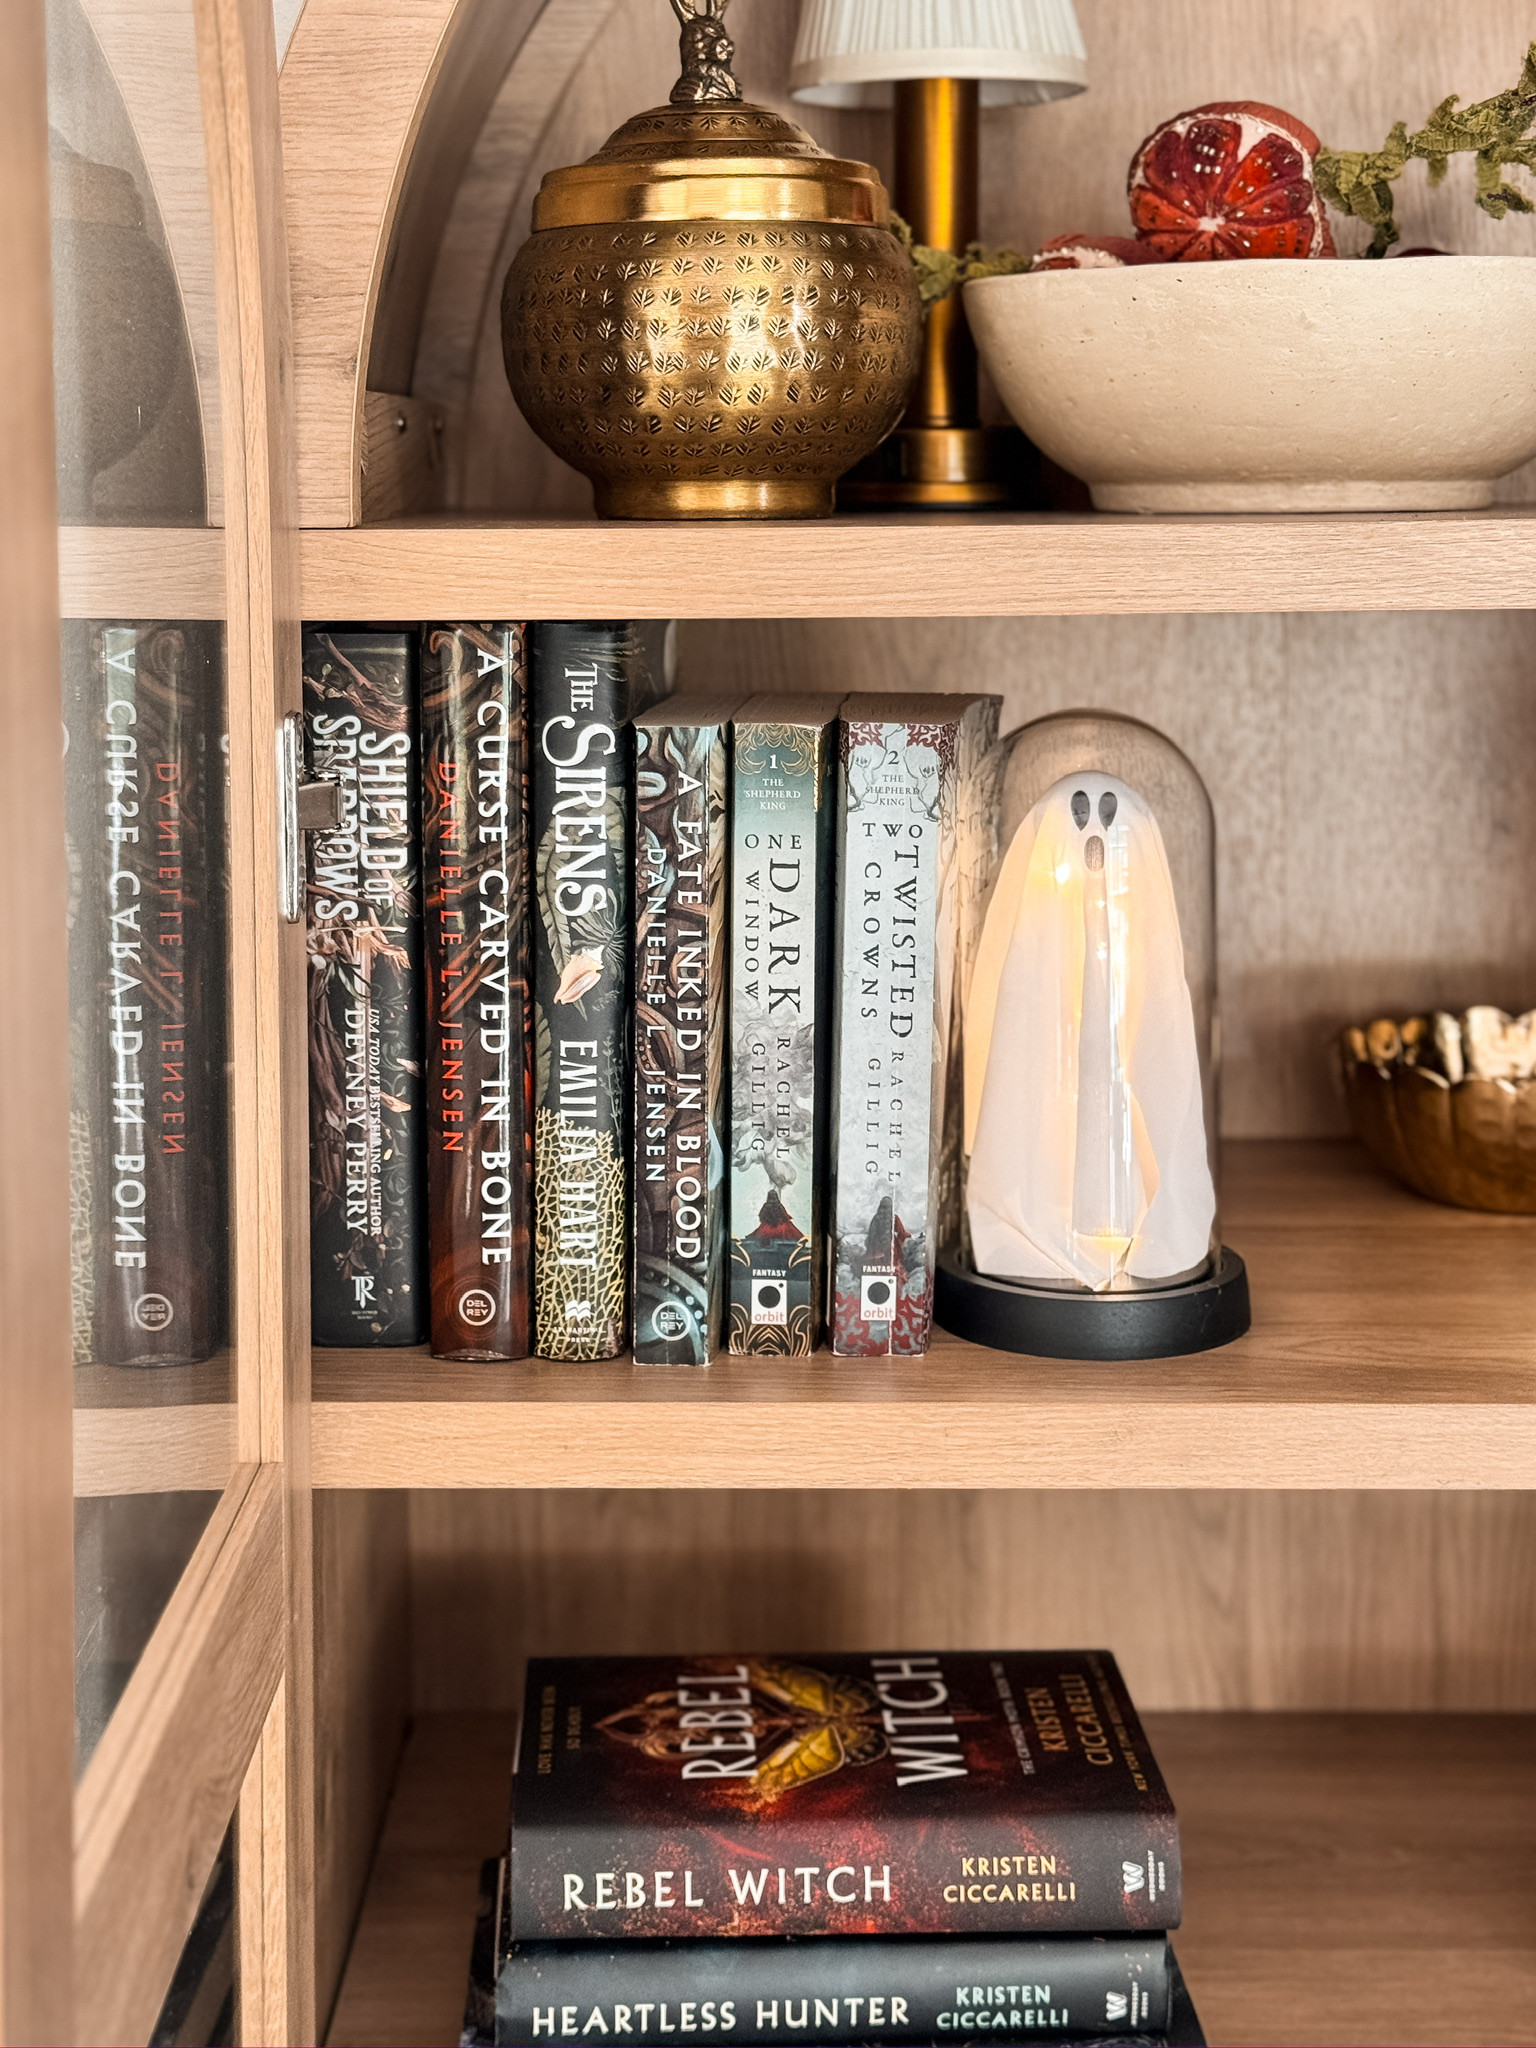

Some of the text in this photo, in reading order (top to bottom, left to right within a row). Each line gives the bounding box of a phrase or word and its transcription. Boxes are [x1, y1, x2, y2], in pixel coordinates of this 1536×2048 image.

[768, 754, 778, 770] 1
[882, 774, 905, 783] THE
[887, 750, 900, 766] 2
[541, 664, 616, 916] THE SIRENS
[744, 789, 801, 800] SHEPHERD
[762, 778, 785, 788] THE
[865, 786, 920, 796] SHEPHERD
[879, 797, 906, 807] KING
[359, 732, 411, 907] SHIELD OF
[759, 800, 786, 811] KING
[744, 833, 802, 850] ONE
[862, 823, 923, 840] TWO
[437, 761, 464, 1152] DANIELLE L. JENSEN
[744, 870, 760, 1001] WINDOW
[767, 857, 802, 1015] DARK
[860, 861, 882, 1019] CROWNS
[889, 846, 920, 1039] TWISTED
[476, 649, 512, 1265] A CURSE CARVED IN BONE
[369, 1008, 380, 1032] USA
[645, 847, 668, 1182] DANIELLE L. JENSEN
[675, 771, 703, 1259] A FATE INKED IN BLOOD
[369, 1037, 381, 1084] TODAY
[750, 1042, 766, 1153] GILLIG
[776, 1037, 791, 1159] RACHEL
[866, 1058, 882, 1174] GILLIG
[888, 1051, 906, 1182] RACHEL
[345, 1008, 368, 1235] DEVNEY PERRY
[559, 1040, 598, 1271] EMILIA HART
[370, 1177, 383, 1237] AUTHOR
[752, 1268, 787, 1278] FANTASY
[862, 1264, 897, 1273] FANTASY
[466, 1299, 488, 1307] DEL
[466, 1309, 489, 1317] REY
[660, 1311, 684, 1320] DEL
[753, 1308, 785, 1323] orbit
[863, 1304, 894, 1319] orbit
[660, 1322, 684, 1331] REY
[677, 1664, 758, 1780] REBEL
[870, 1657, 968, 1787] WITCH
[1024, 1687, 1069, 1752] KRISTEN
[1059, 1673, 1113, 1766] CICCARELLI
[962, 1855, 1056, 1878] KRISTEN
[562, 1865, 891, 1912] REBEL WITCH
[943, 1881, 1077, 1904] CICCARELLI
[956, 1984, 1051, 2007] KRISTEN
[532, 1996, 910, 2038] HEARTLESS HUNTER
[936, 2008, 1069, 2031] CICCARELLI
